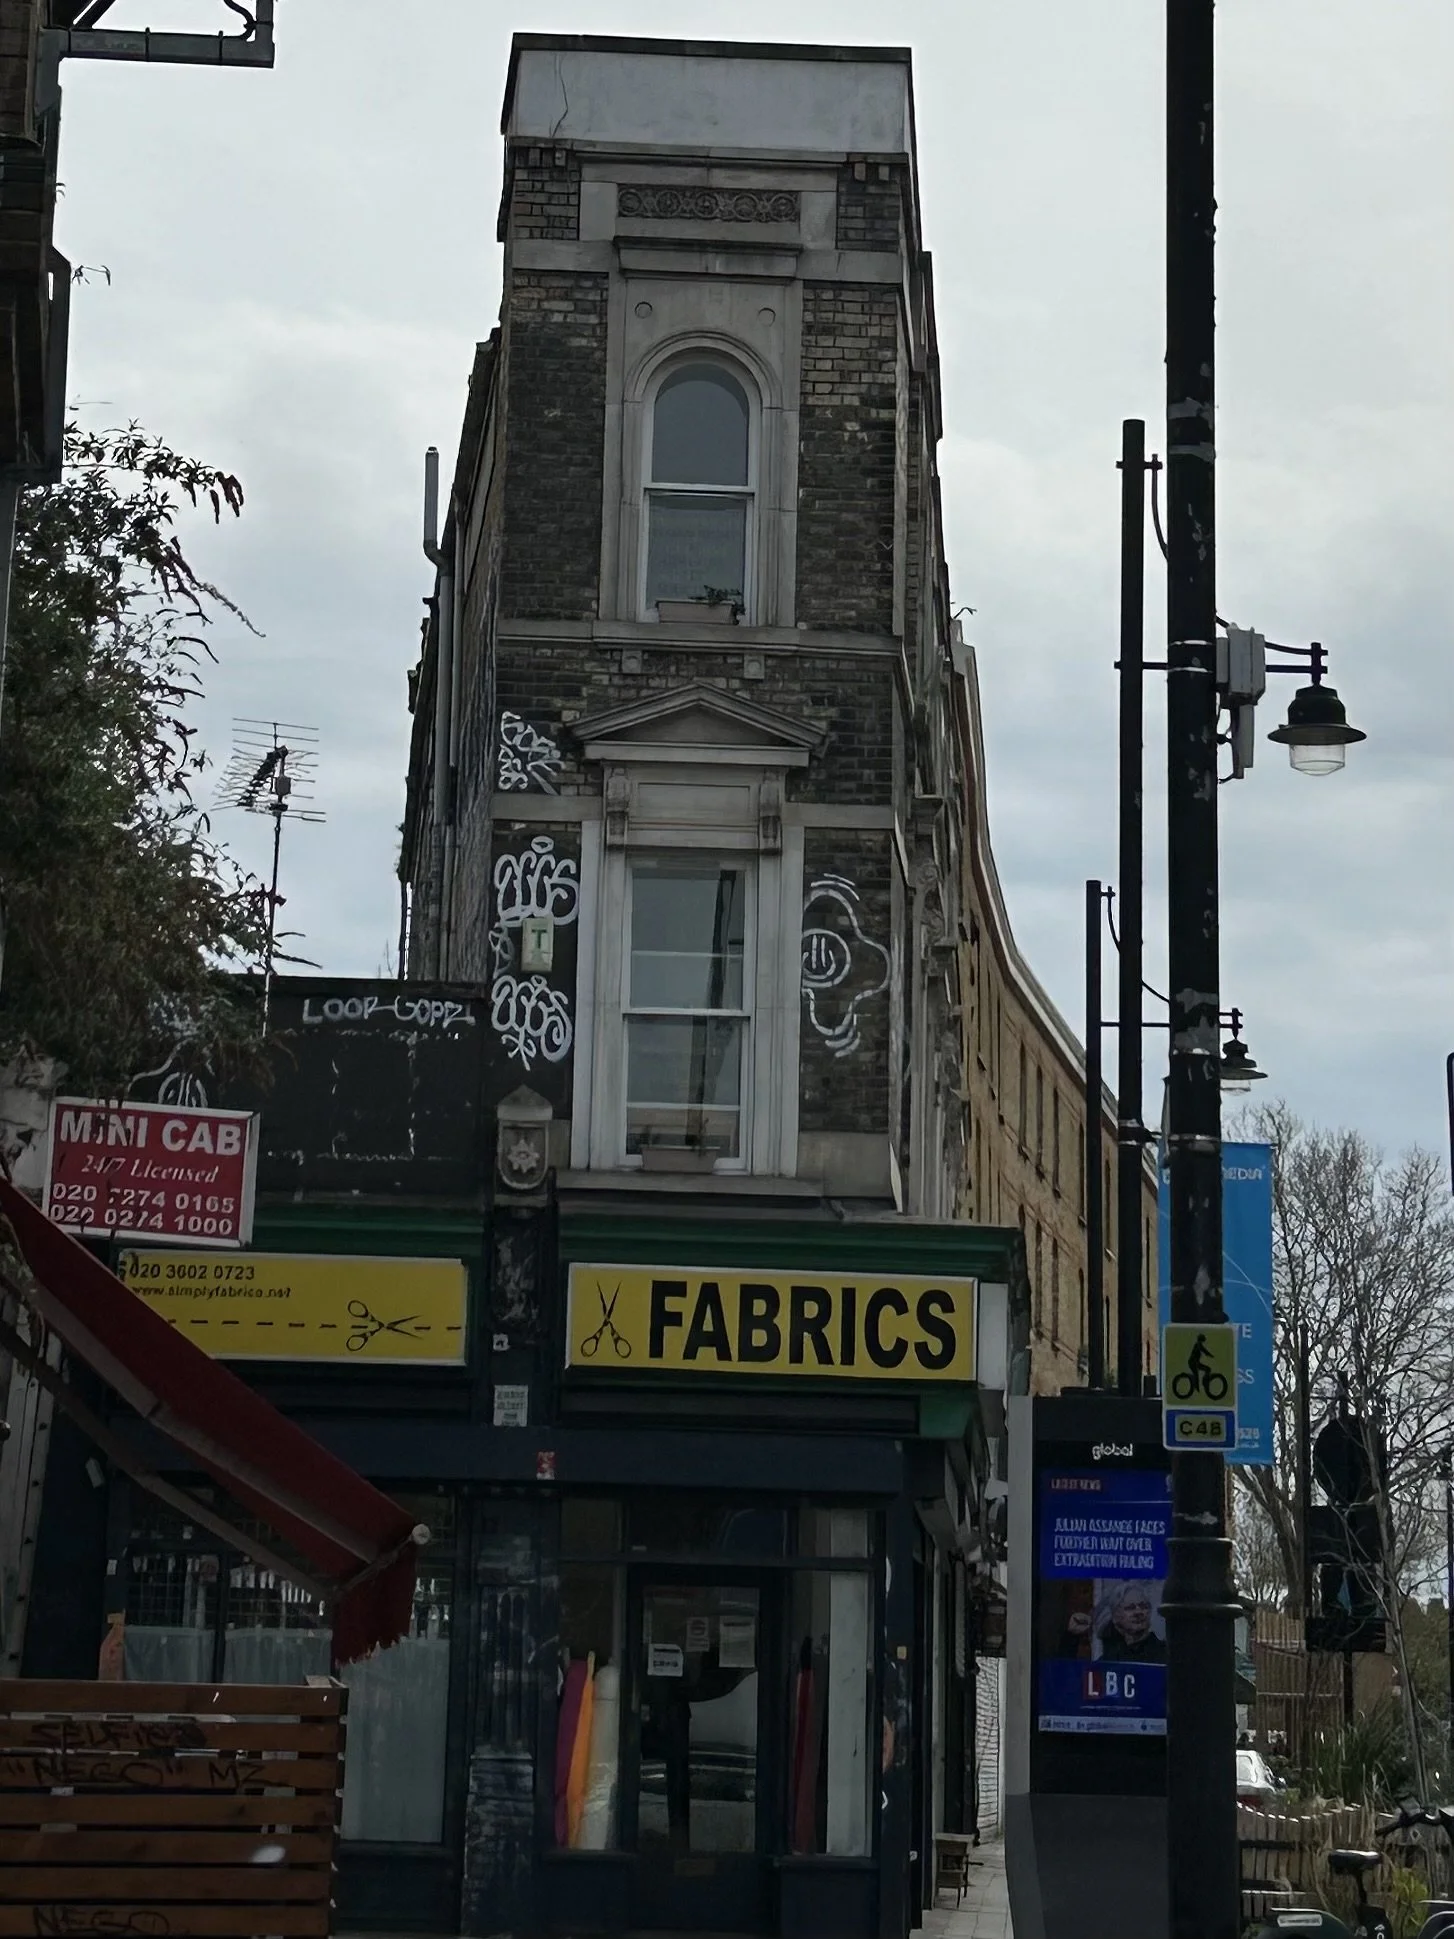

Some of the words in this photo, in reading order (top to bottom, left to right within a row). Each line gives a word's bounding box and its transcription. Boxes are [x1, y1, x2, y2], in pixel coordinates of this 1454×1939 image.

[60, 1110, 149, 1148] MINI
[161, 1118, 241, 1156] CAB
[81, 1154, 127, 1175] 24/7
[129, 1158, 219, 1184] Licensed
[52, 1182, 98, 1202] 020
[50, 1204, 95, 1224] 020
[174, 1214, 233, 1235] 1000
[129, 1263, 161, 1278] 020
[213, 1265, 256, 1281] 0723
[649, 1280, 957, 1370] FABRICS
[1091, 1443, 1133, 1460] global
[1088, 1671, 1135, 1699] LBC
